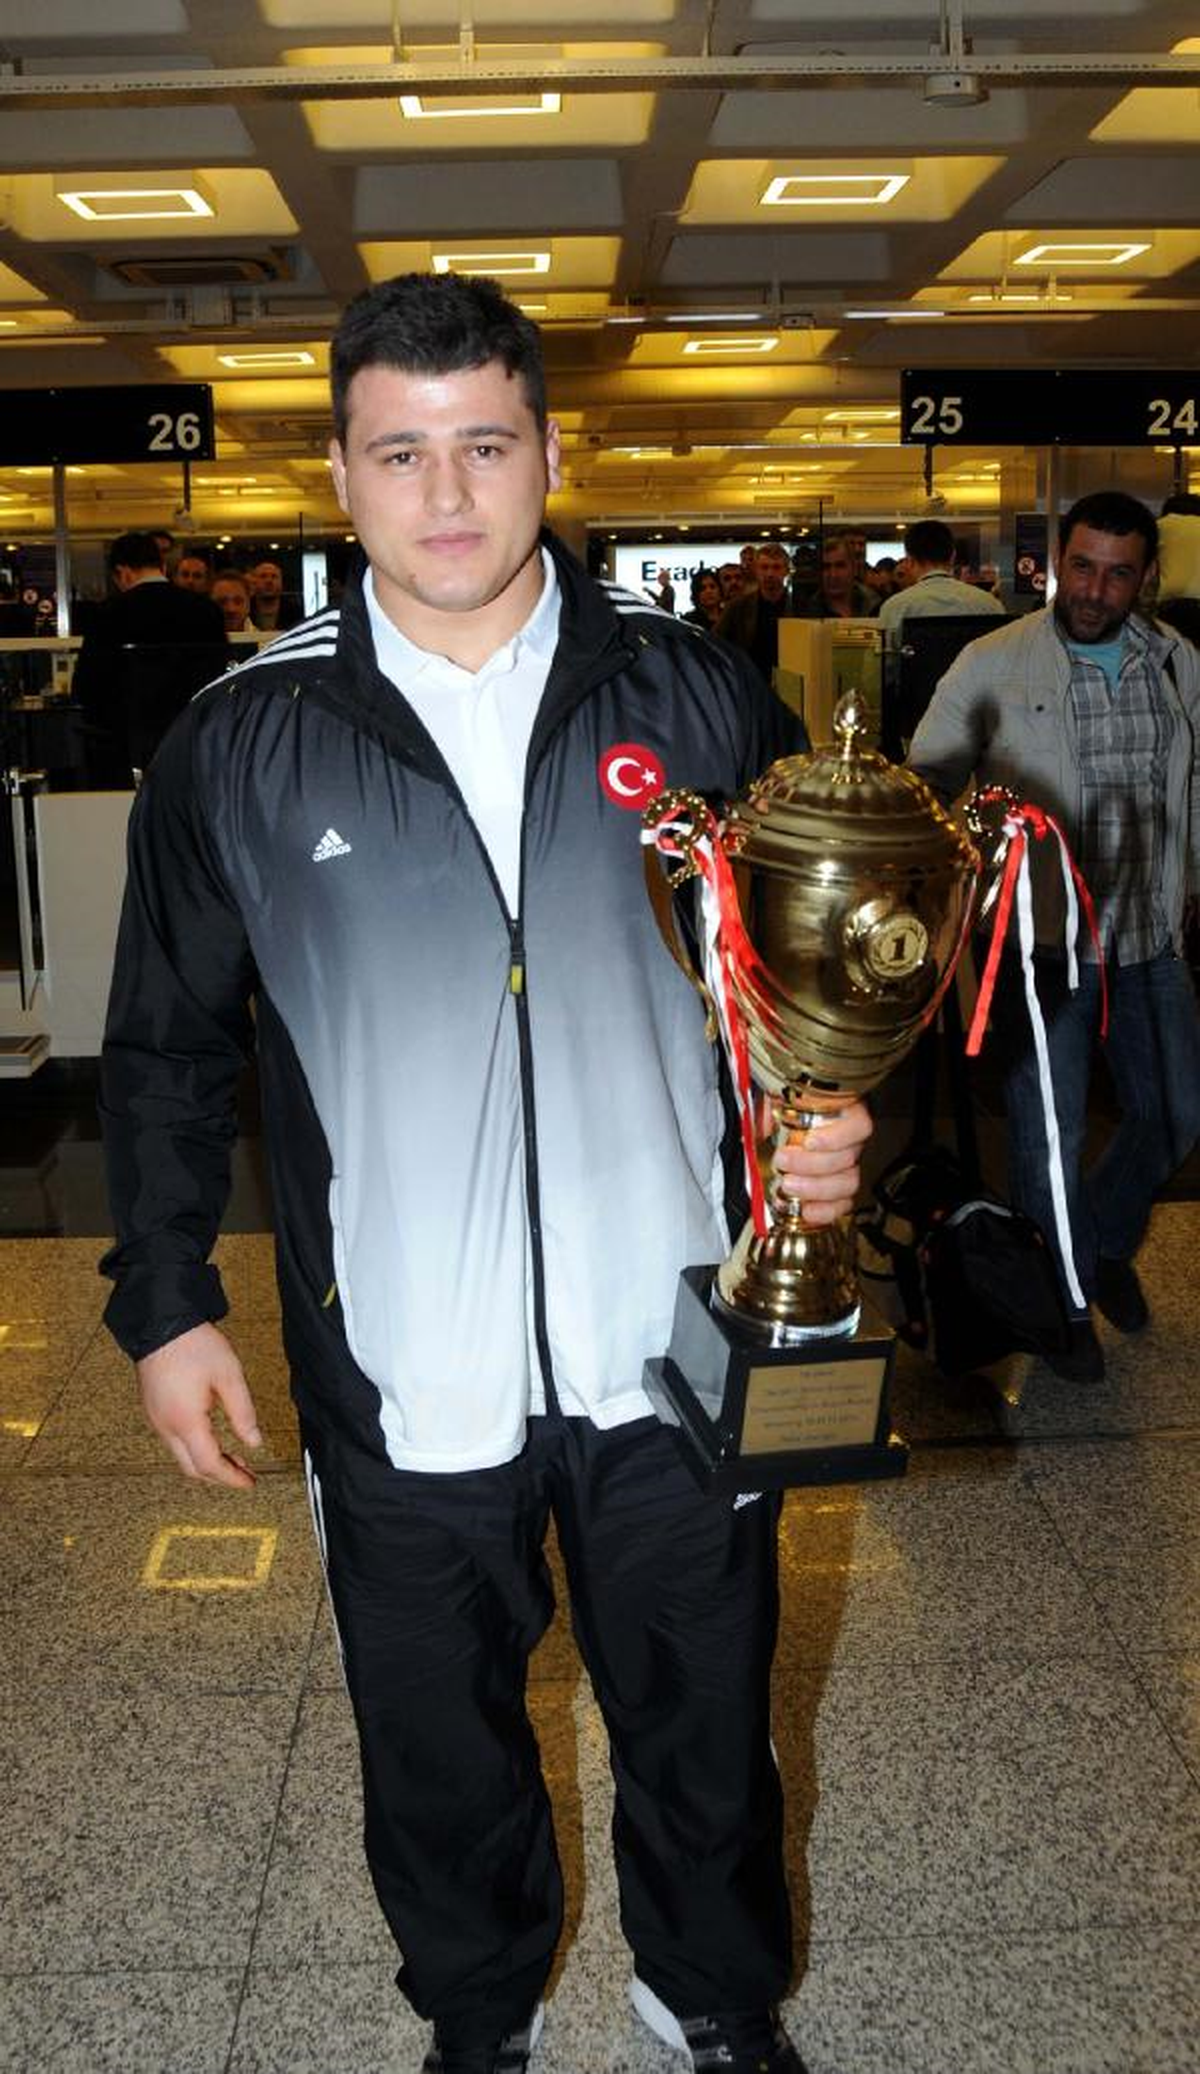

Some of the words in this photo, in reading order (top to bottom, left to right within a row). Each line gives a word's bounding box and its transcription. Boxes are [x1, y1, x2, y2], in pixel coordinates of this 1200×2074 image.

[147, 412, 201, 451] 26
[910, 396, 963, 434] 25
[1147, 399, 1199, 436] 24
[889, 933, 907, 961] 1
